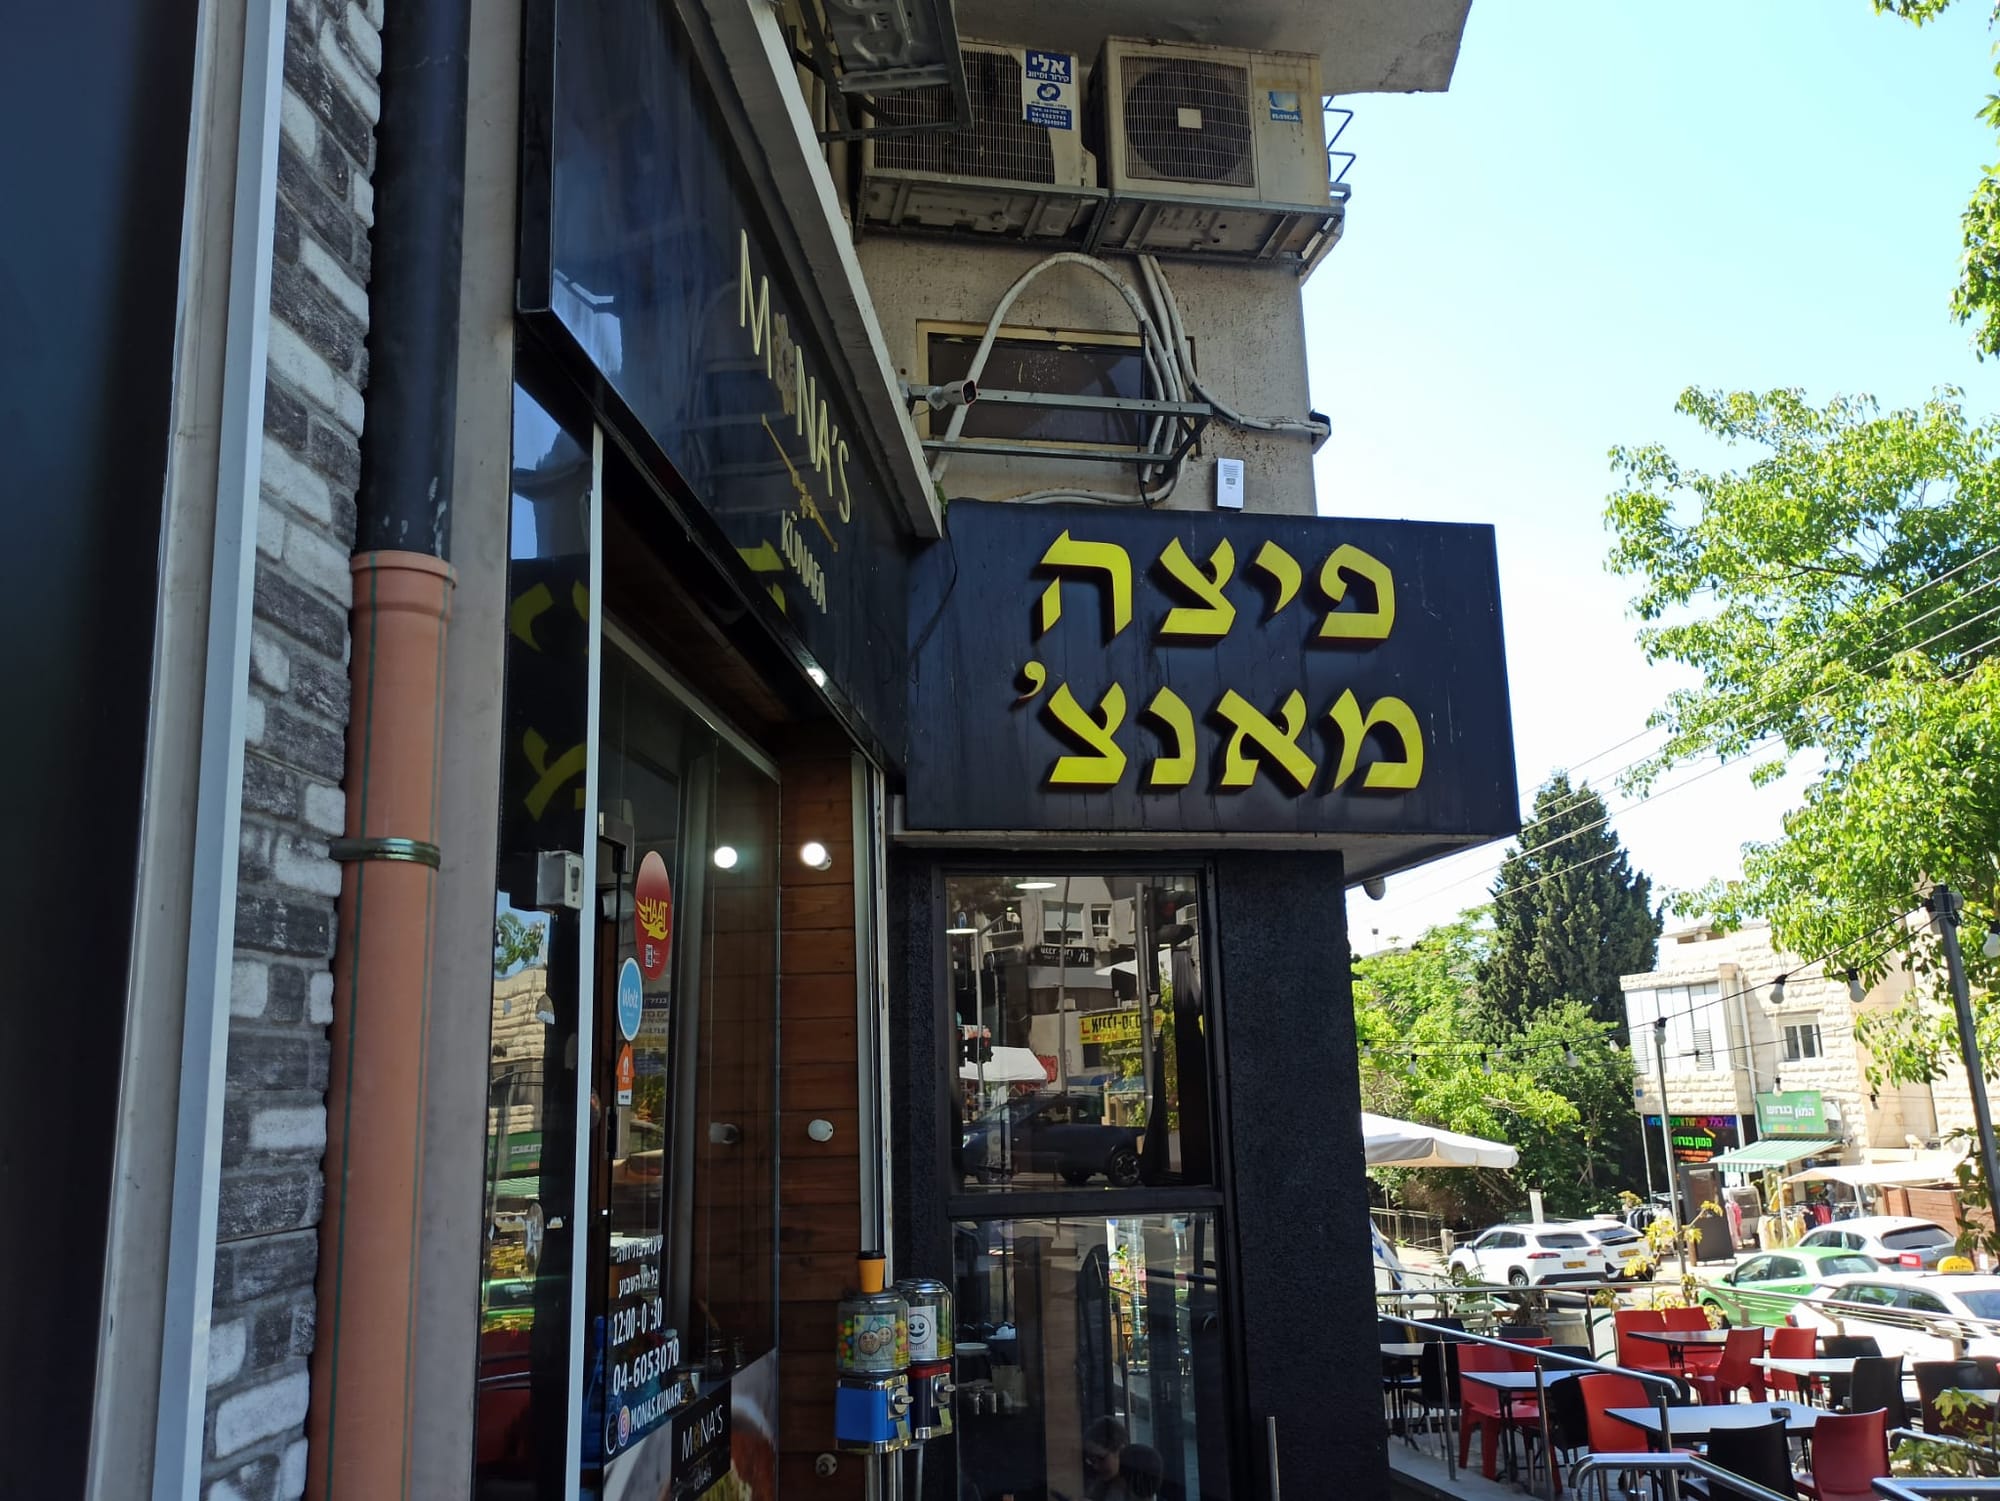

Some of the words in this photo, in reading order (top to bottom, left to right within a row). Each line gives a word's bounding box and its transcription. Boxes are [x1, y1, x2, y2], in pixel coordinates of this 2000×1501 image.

[1031, 54, 1065, 75] אלי
[1039, 528, 1396, 640] פיצה
[644, 896, 668, 932] HAAT
[622, 986, 639, 1009] Wolt
[612, 1337, 680, 1396] 04-6053070
